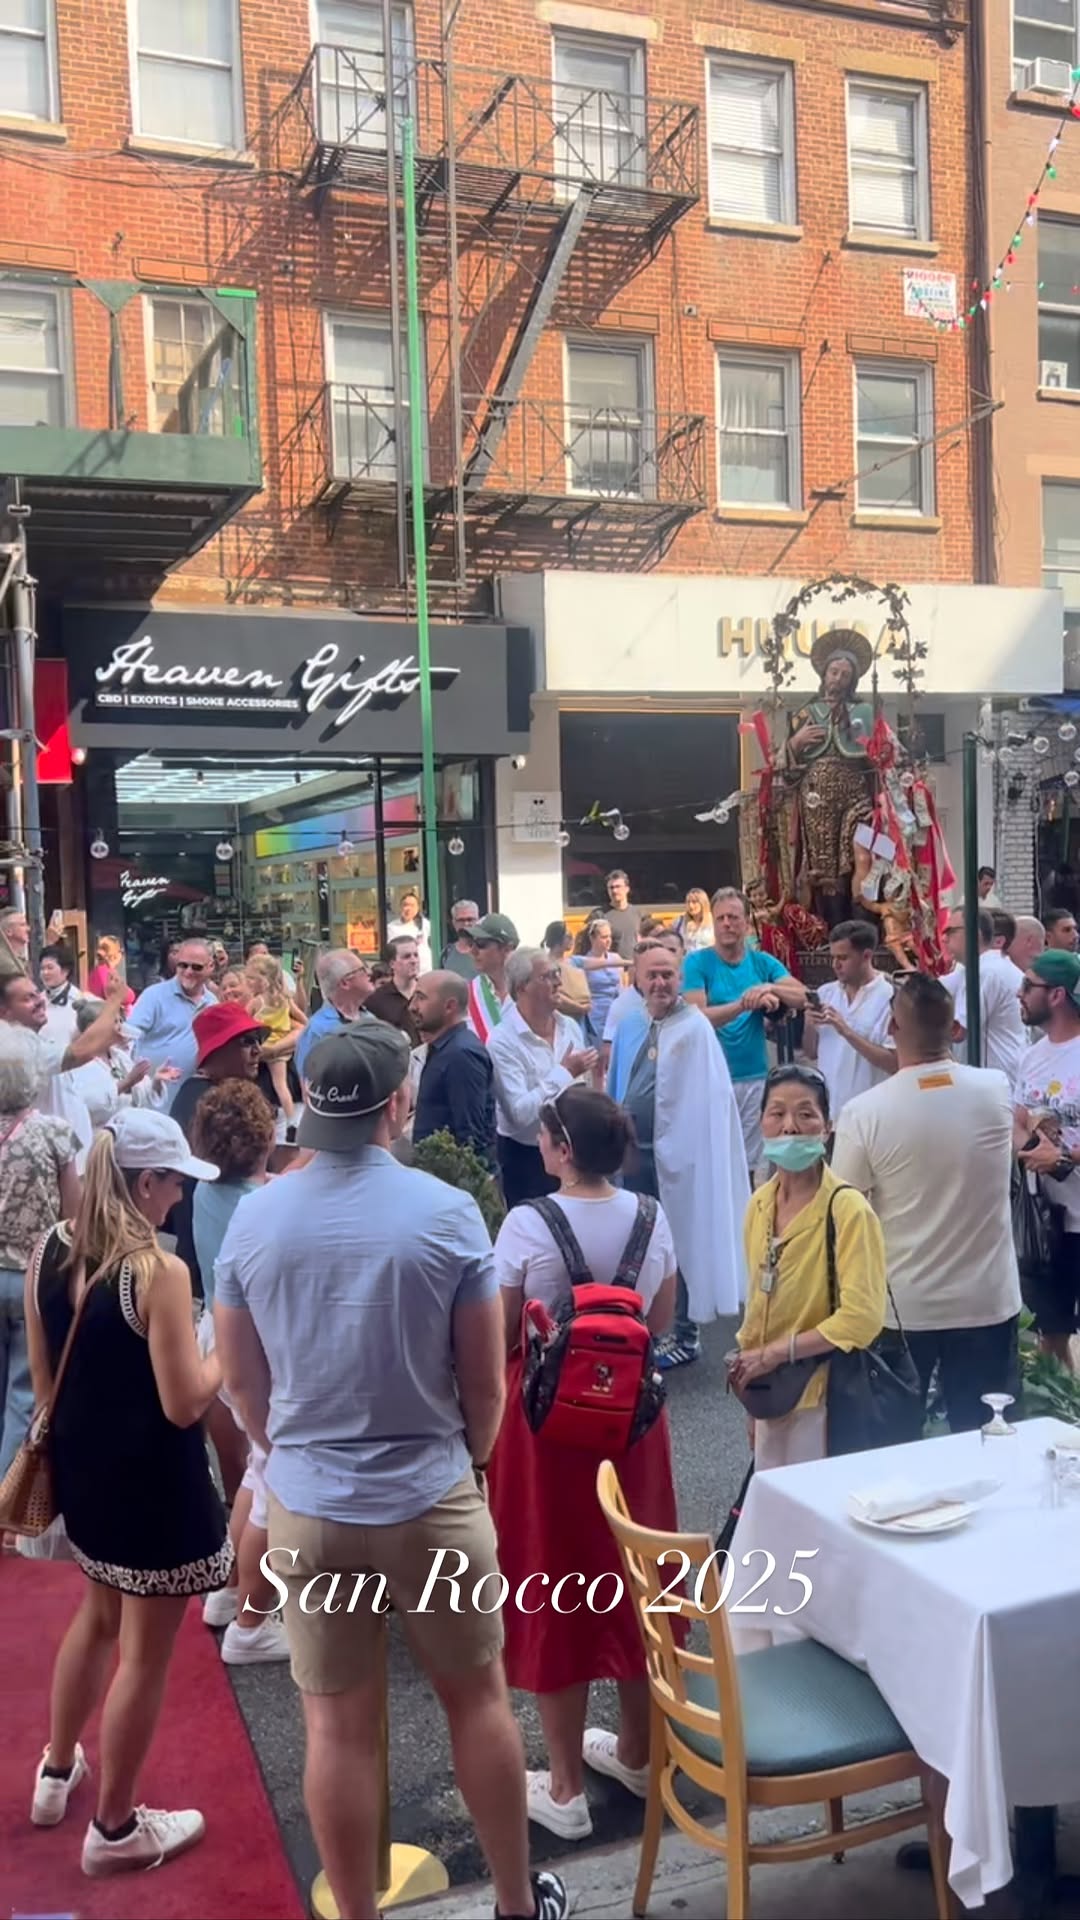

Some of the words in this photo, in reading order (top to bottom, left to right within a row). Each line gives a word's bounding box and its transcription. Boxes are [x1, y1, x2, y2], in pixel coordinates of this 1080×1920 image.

[95, 635, 283, 688] Heaven
[301, 642, 461, 726] Gifts
[97, 694, 122, 704] CBD
[130, 695, 177, 706] EXOTICS
[186, 696, 224, 707] SMOKE
[226, 697, 299, 709] ACCESSORIES
[120, 869, 170, 888] Heaven
